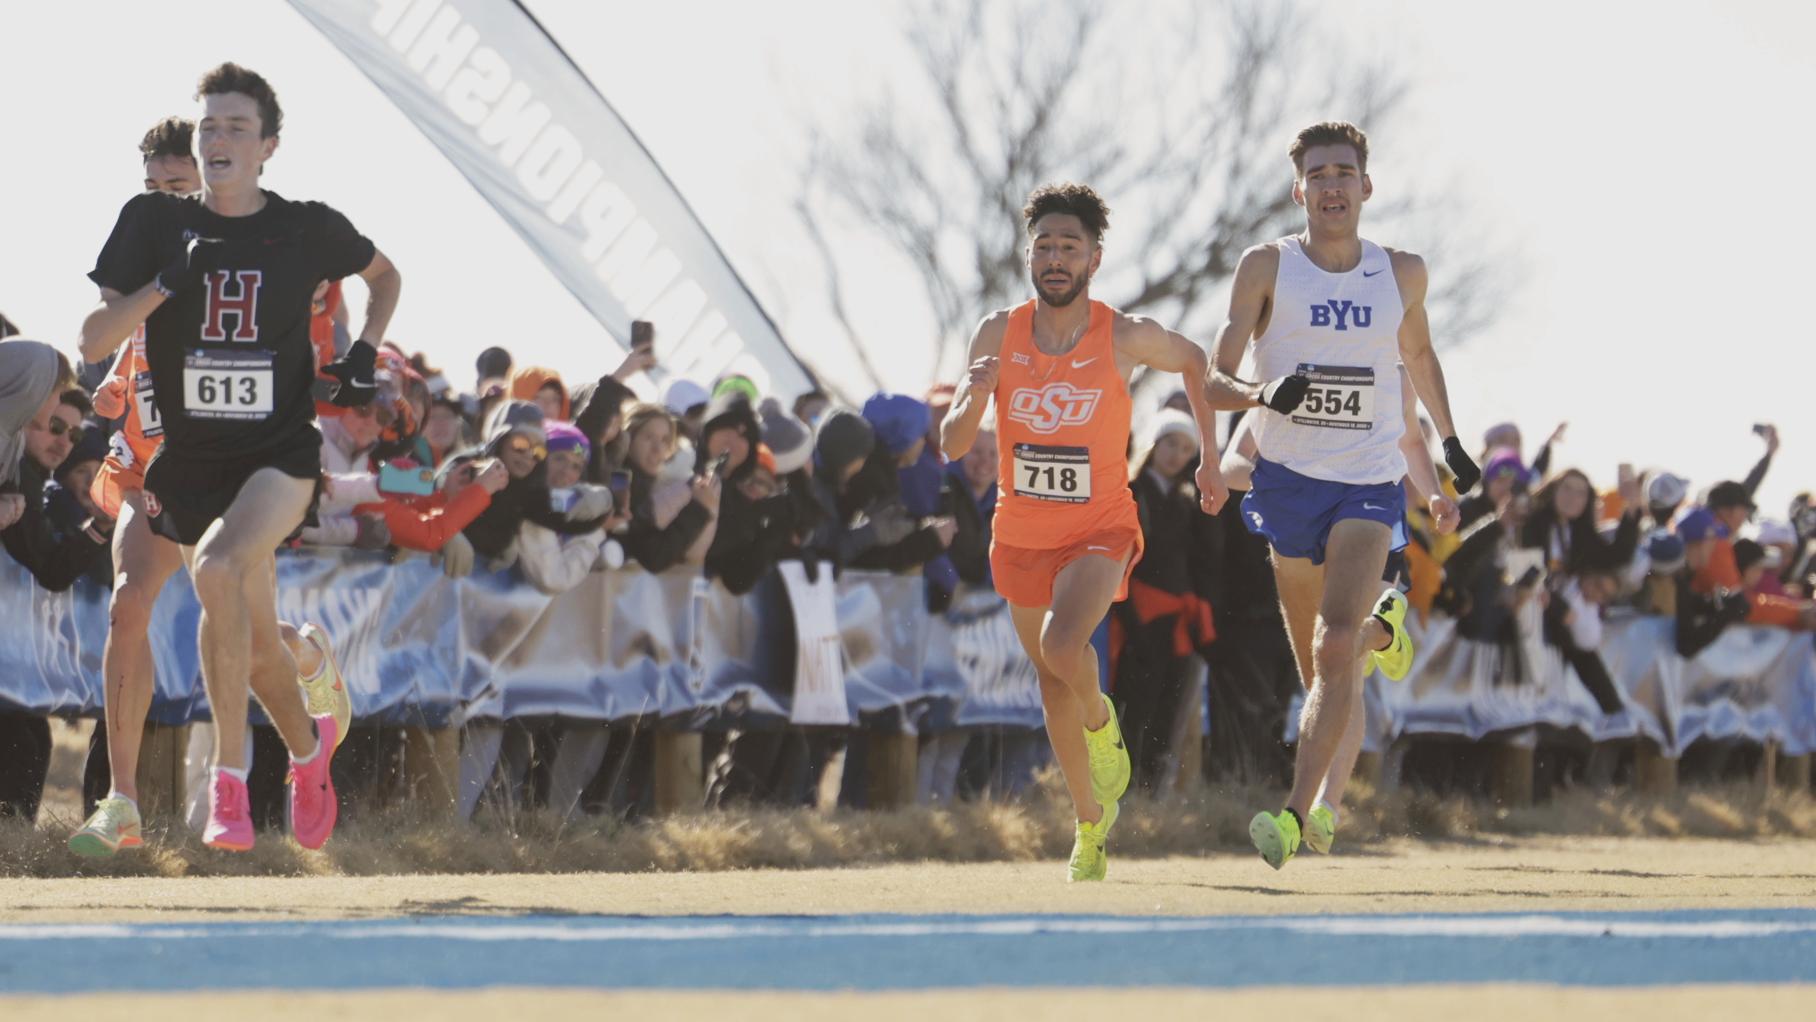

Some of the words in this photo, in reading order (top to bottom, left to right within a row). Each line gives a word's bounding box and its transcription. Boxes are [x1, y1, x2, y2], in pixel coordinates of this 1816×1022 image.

[201, 270, 262, 342] H
[1310, 299, 1372, 331] BYU
[198, 375, 258, 406] 613
[1305, 387, 1361, 416] 554
[1008, 382, 1104, 435] OSU
[1024, 465, 1078, 492] 718
